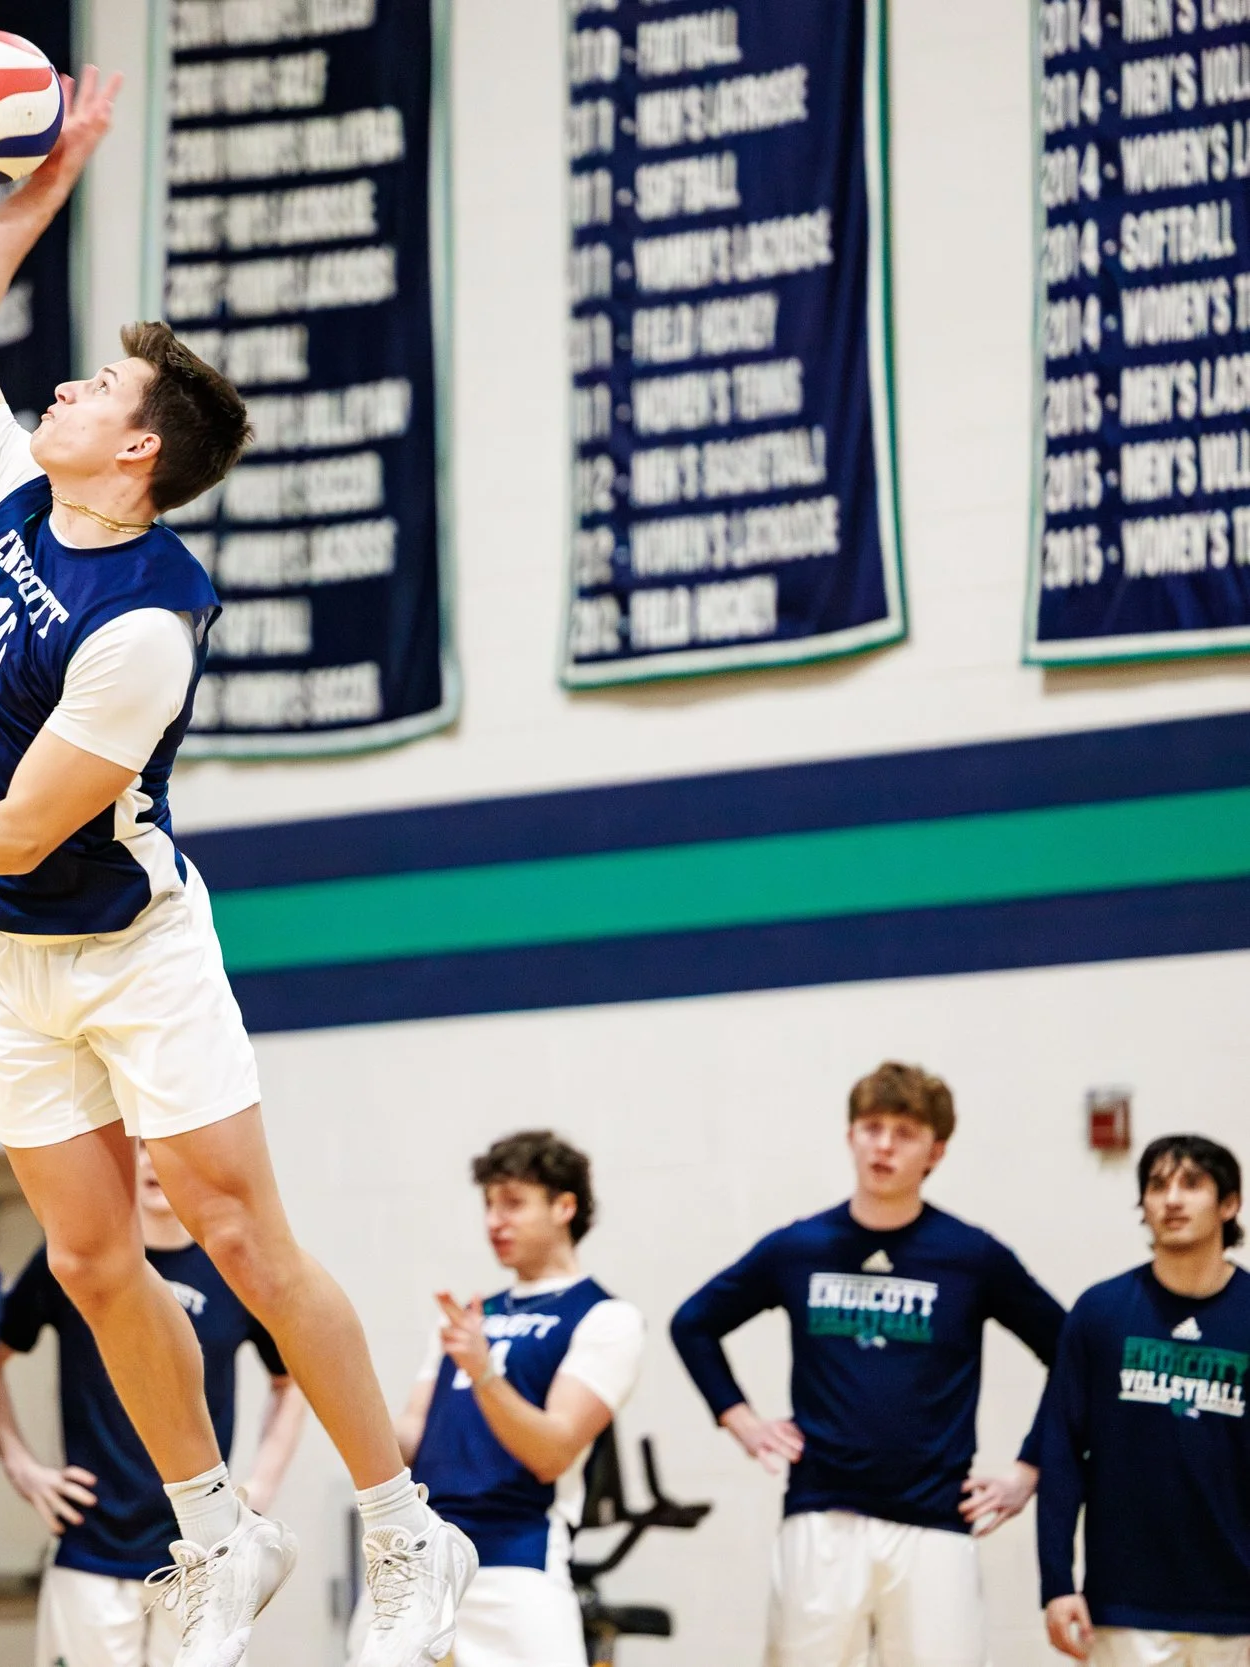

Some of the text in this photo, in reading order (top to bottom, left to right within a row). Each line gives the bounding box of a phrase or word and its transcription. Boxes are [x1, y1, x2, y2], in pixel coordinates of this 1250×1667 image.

[1121, 52, 1197, 120] MEN'S
[1119, 122, 1230, 195] WOMEN'S
[1120, 198, 1237, 273] SOFTBALL
[1120, 275, 1232, 348] WOMEN'S
[1120, 359, 1197, 429] MEN'S
[1120, 436, 1197, 504] MEN'S
[1120, 508, 1230, 579] WOMEN'S
[808, 1272, 938, 1317] ENDICOTT
[1119, 1368, 1246, 1412] VOLLEYBALL
